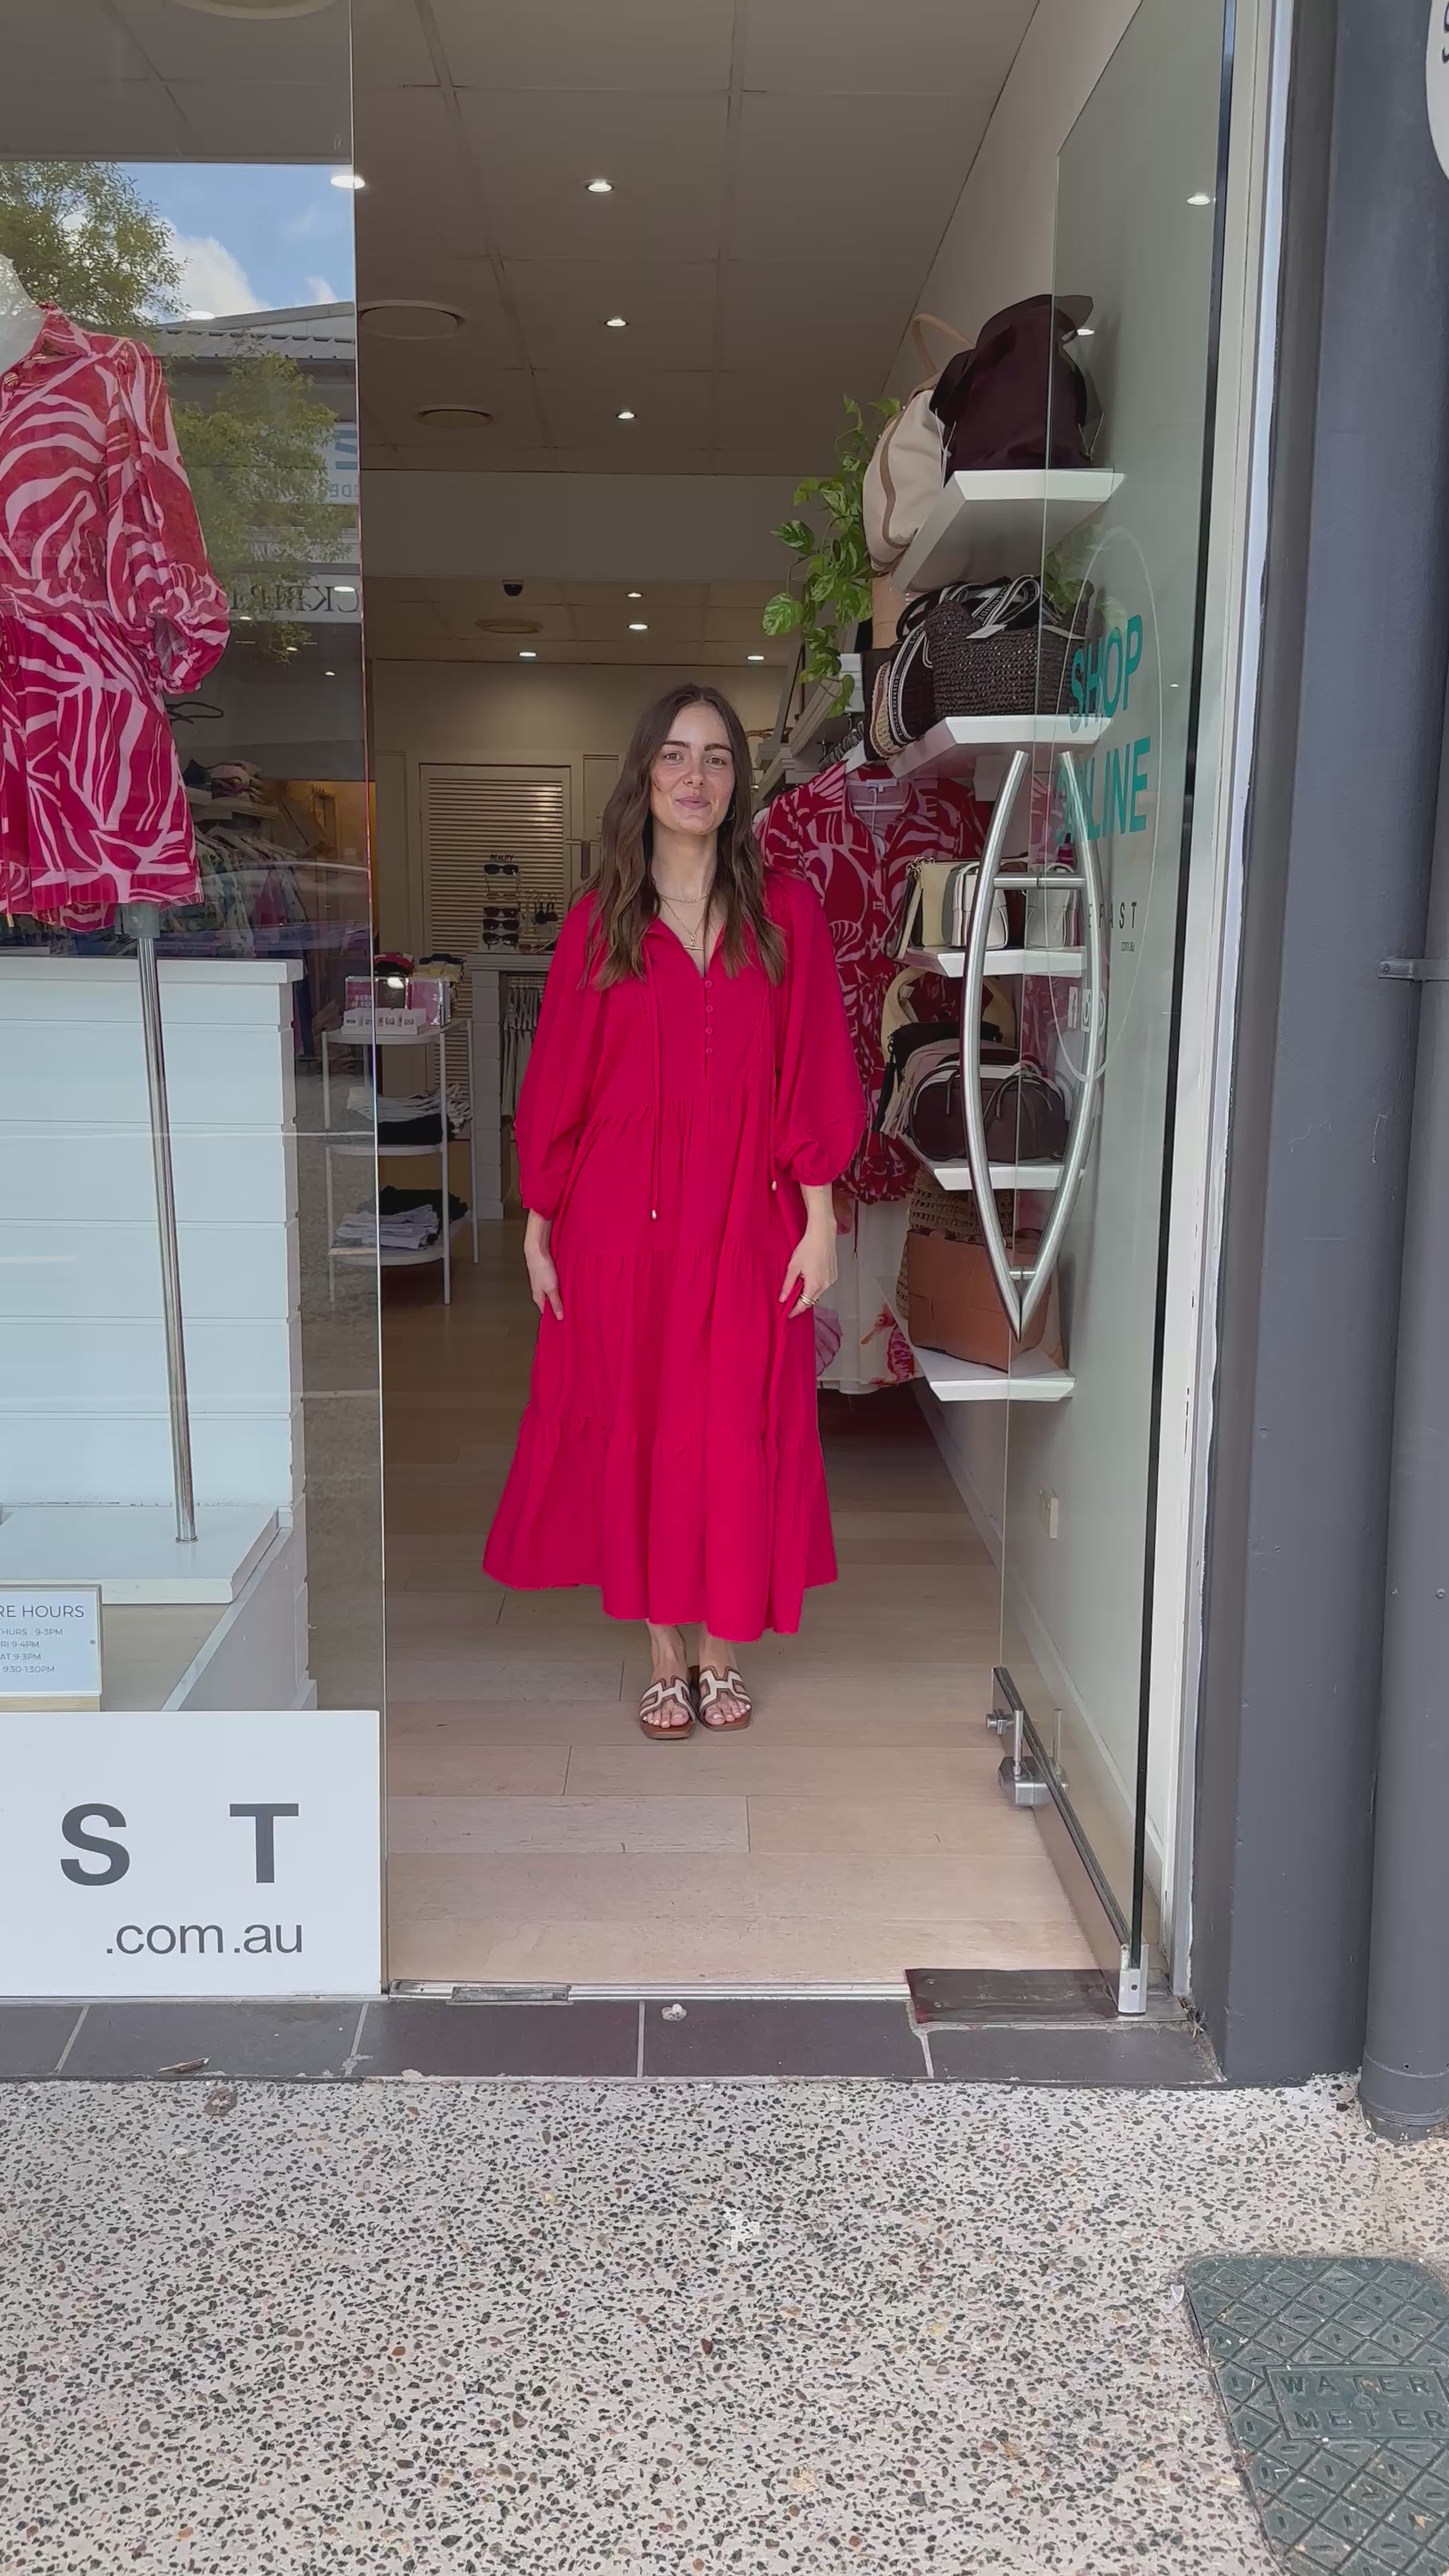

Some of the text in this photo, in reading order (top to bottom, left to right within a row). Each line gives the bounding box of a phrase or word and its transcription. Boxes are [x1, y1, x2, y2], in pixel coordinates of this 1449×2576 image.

[1069, 614, 1142, 734] SHOP
[21, 1605, 85, 1618] HOURS
[13, 1653, 42, 1661] 9-3PM
[105, 1924, 303, 1954] .com.au
[1279, 2375, 1434, 2396] WATER
[1293, 2408, 1449, 2430] METER
